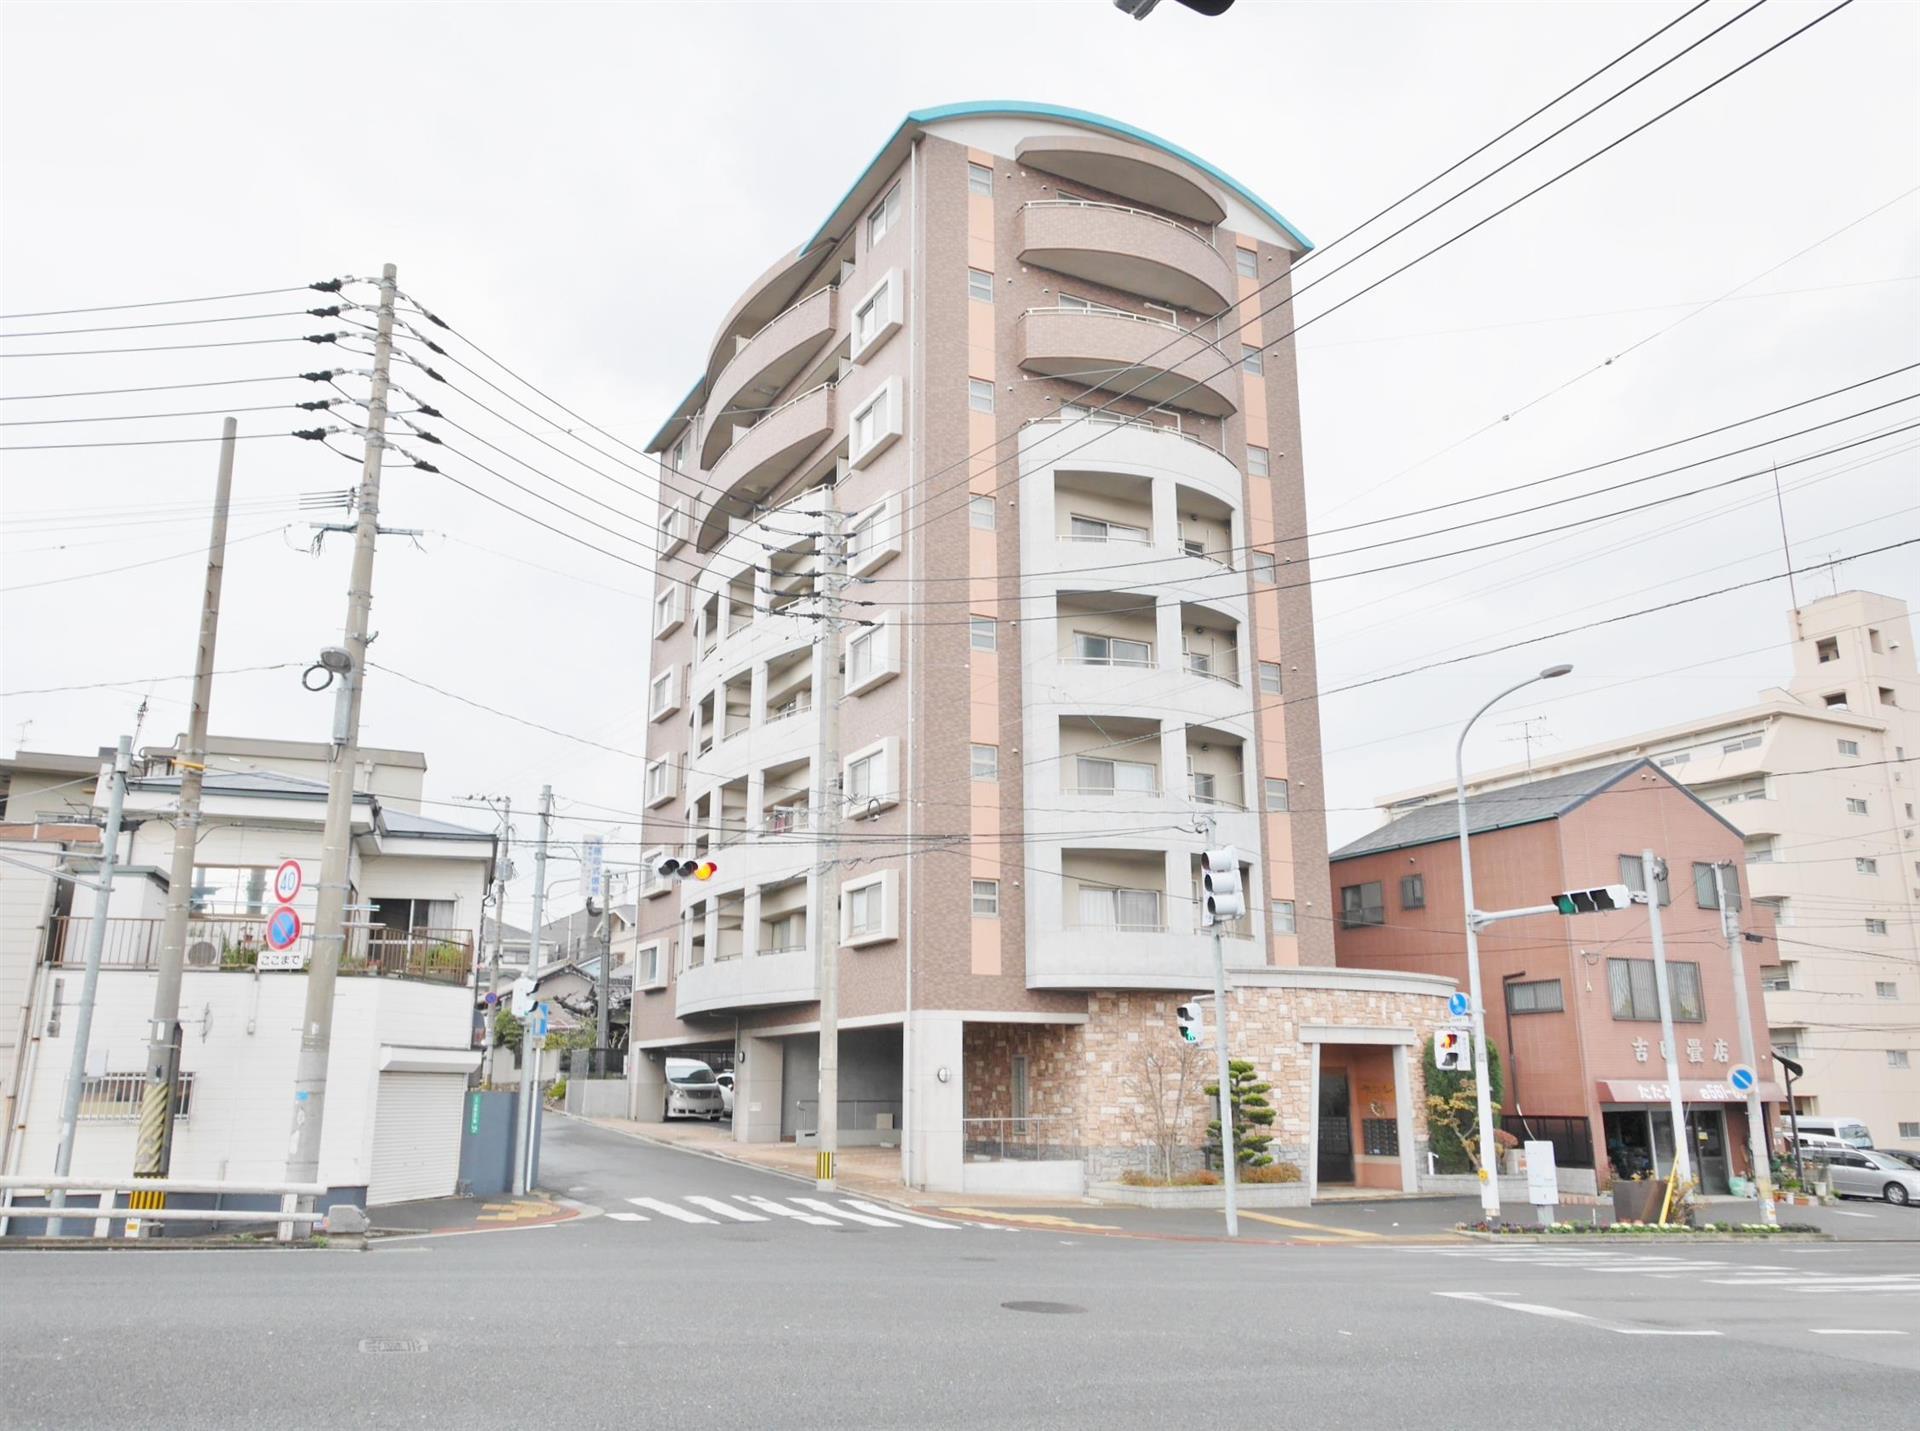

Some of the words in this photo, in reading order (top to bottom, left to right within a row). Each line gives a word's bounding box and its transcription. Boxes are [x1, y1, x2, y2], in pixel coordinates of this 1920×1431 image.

[280, 871, 296, 890] 40
[261, 955, 300, 965] ここまで
